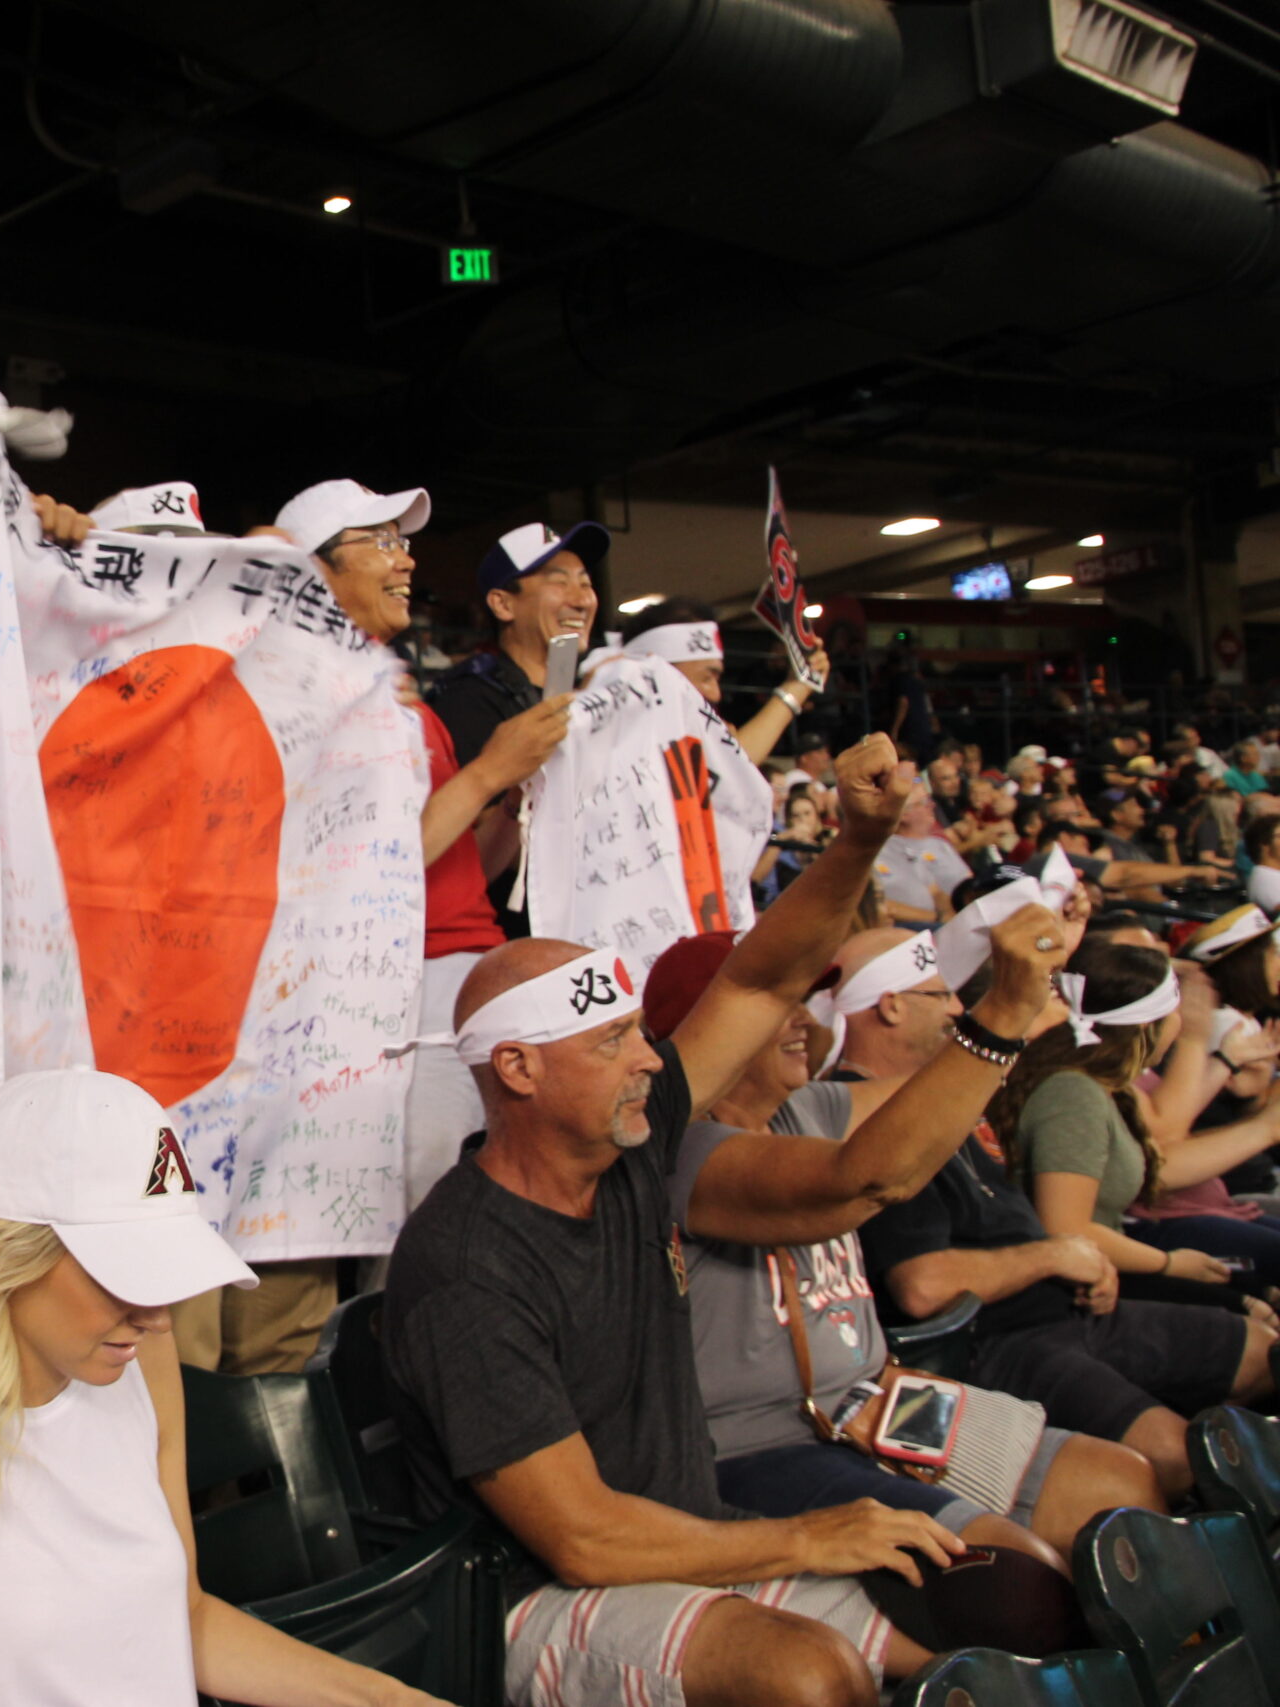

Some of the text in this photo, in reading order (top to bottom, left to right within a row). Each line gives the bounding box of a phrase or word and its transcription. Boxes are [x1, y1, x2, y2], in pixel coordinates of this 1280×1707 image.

[450, 248, 493, 282] EXIT
[151, 490, 185, 515] 必
[569, 967, 617, 1016] 必
